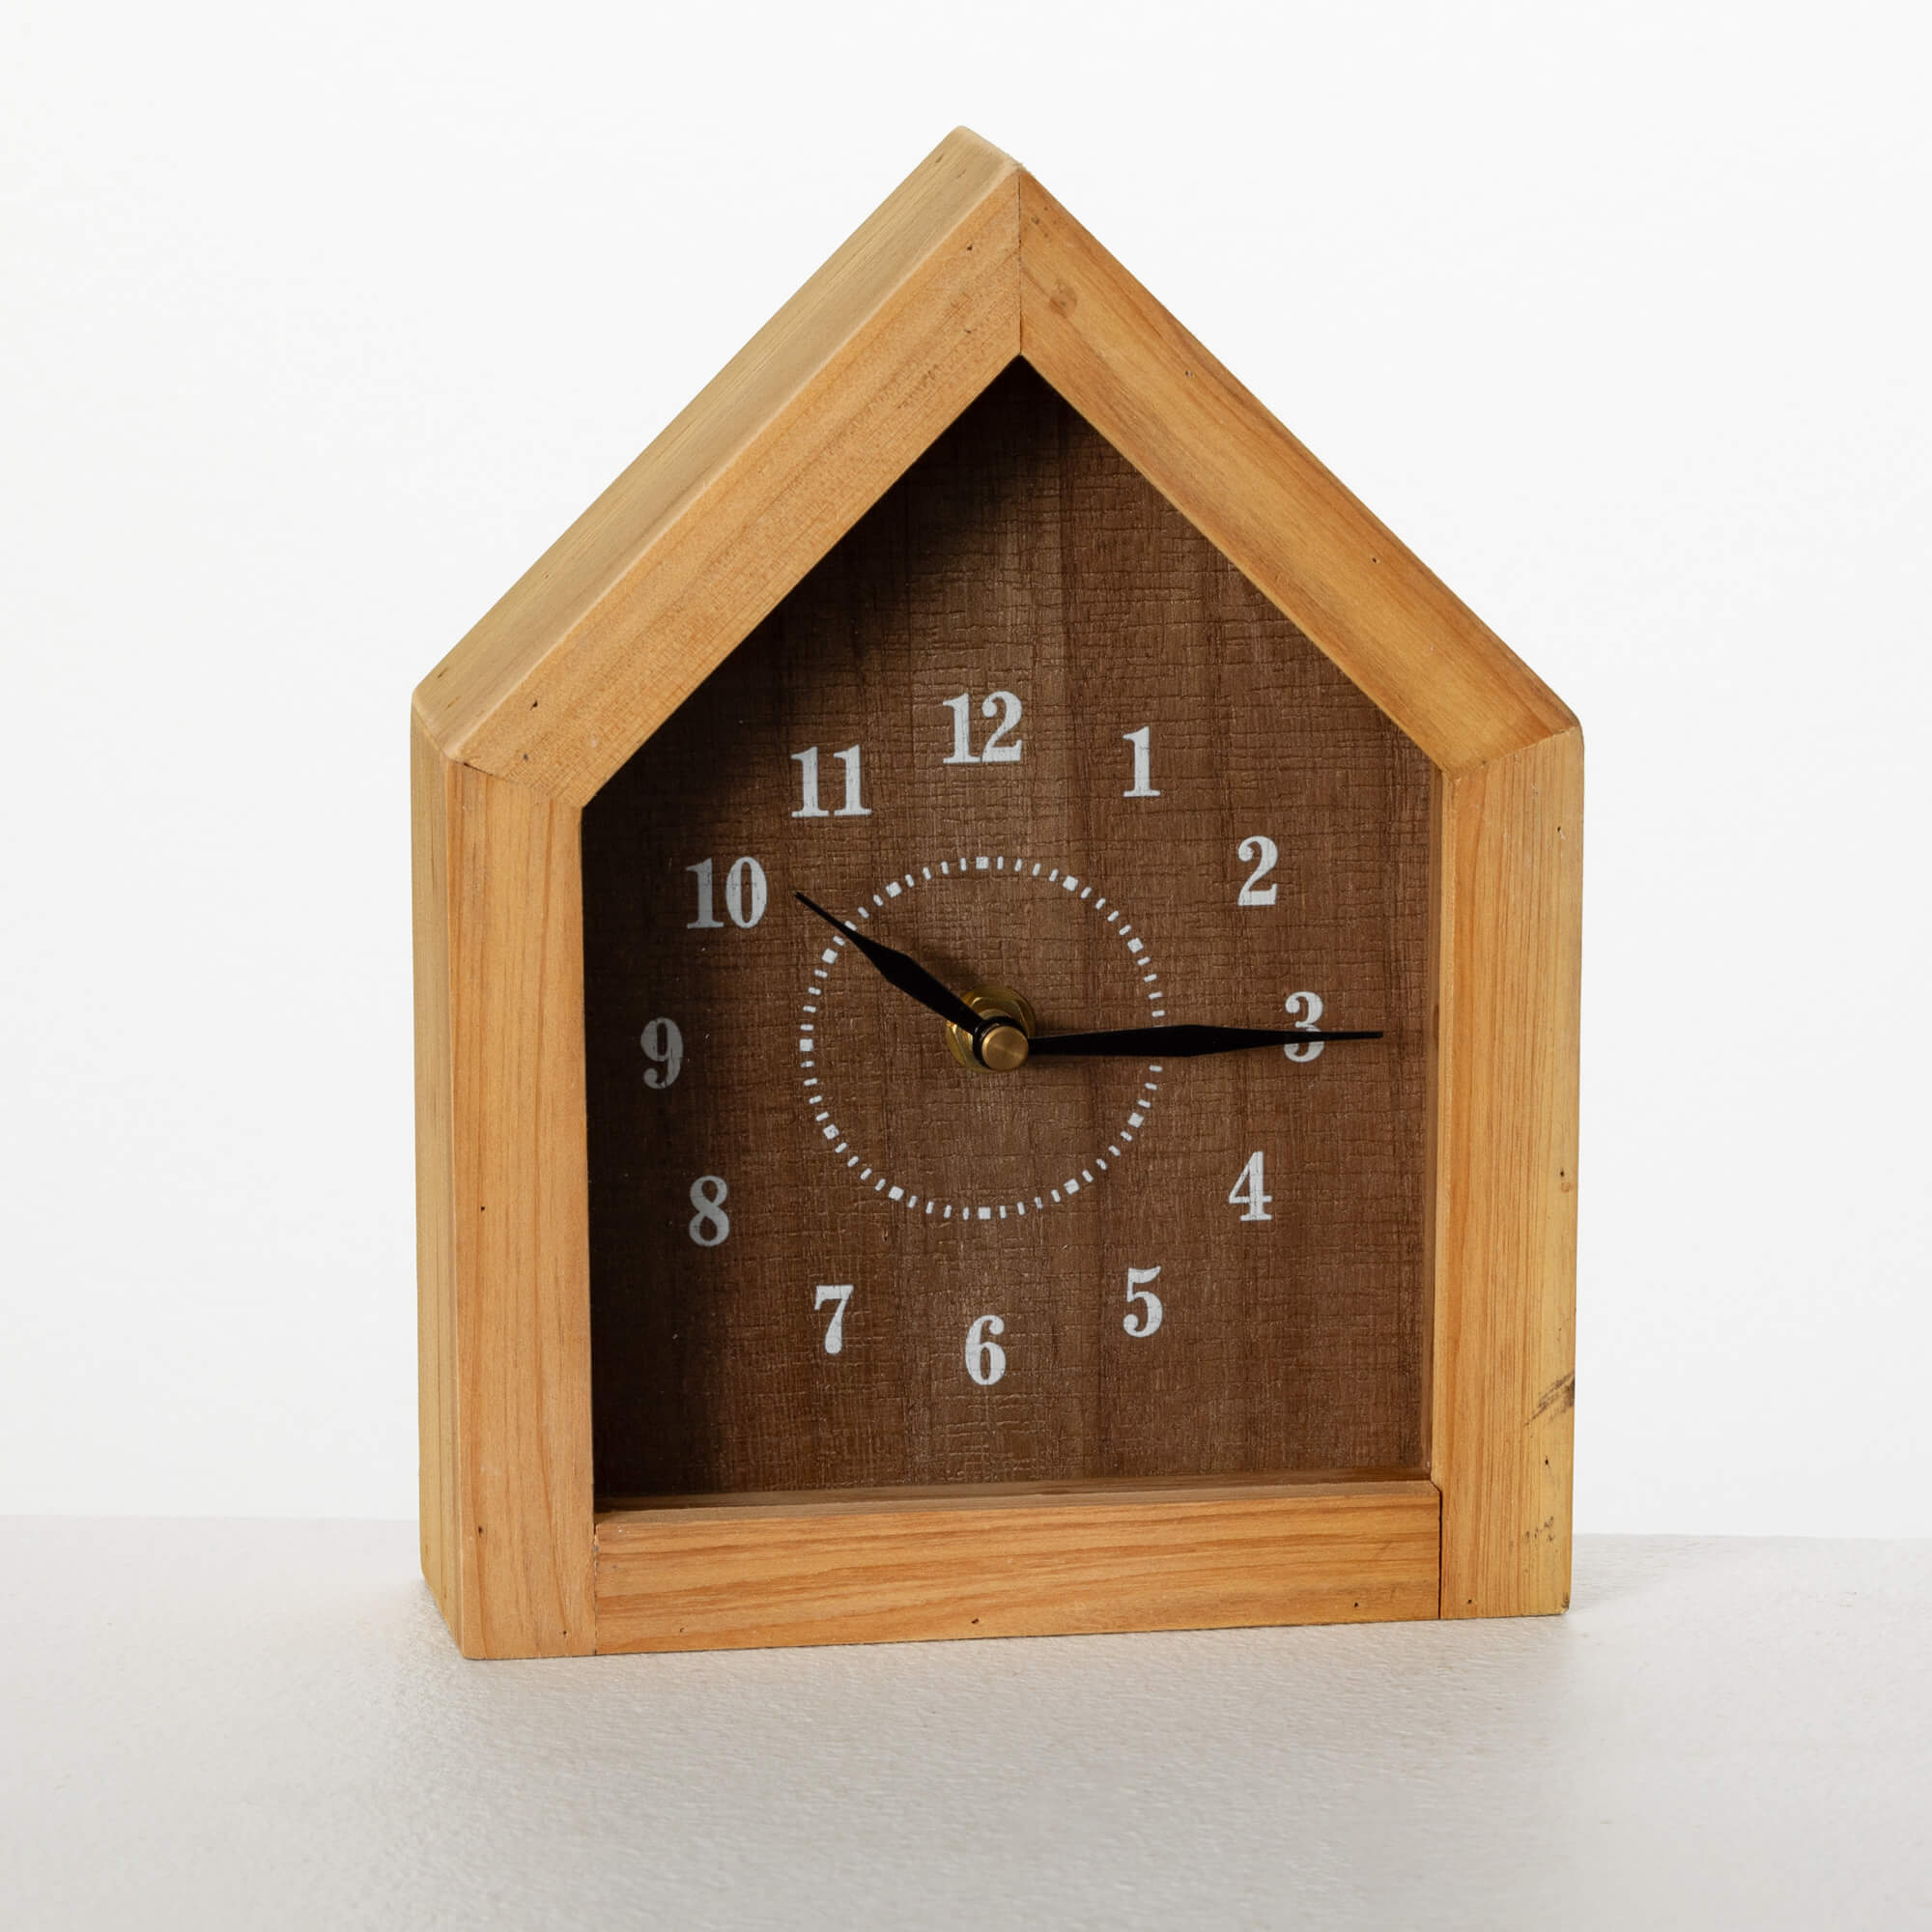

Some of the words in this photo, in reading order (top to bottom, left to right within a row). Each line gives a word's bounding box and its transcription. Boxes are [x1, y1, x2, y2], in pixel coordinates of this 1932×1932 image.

[942, 691, 1023, 765] 12
[1122, 726, 1161, 798] 1
[791, 745, 872, 818] 11
[686, 856, 768, 929] 10
[1236, 836, 1278, 907] 2
[641, 1017, 683, 1089] 9
[1284, 991, 1324, 1063] 3
[689, 1175, 730, 1247] 8
[1228, 1151, 1273, 1222] 4
[813, 1284, 854, 1355] 7
[1123, 1265, 1164, 1338] 5
[964, 1314, 1007, 1386] 6
